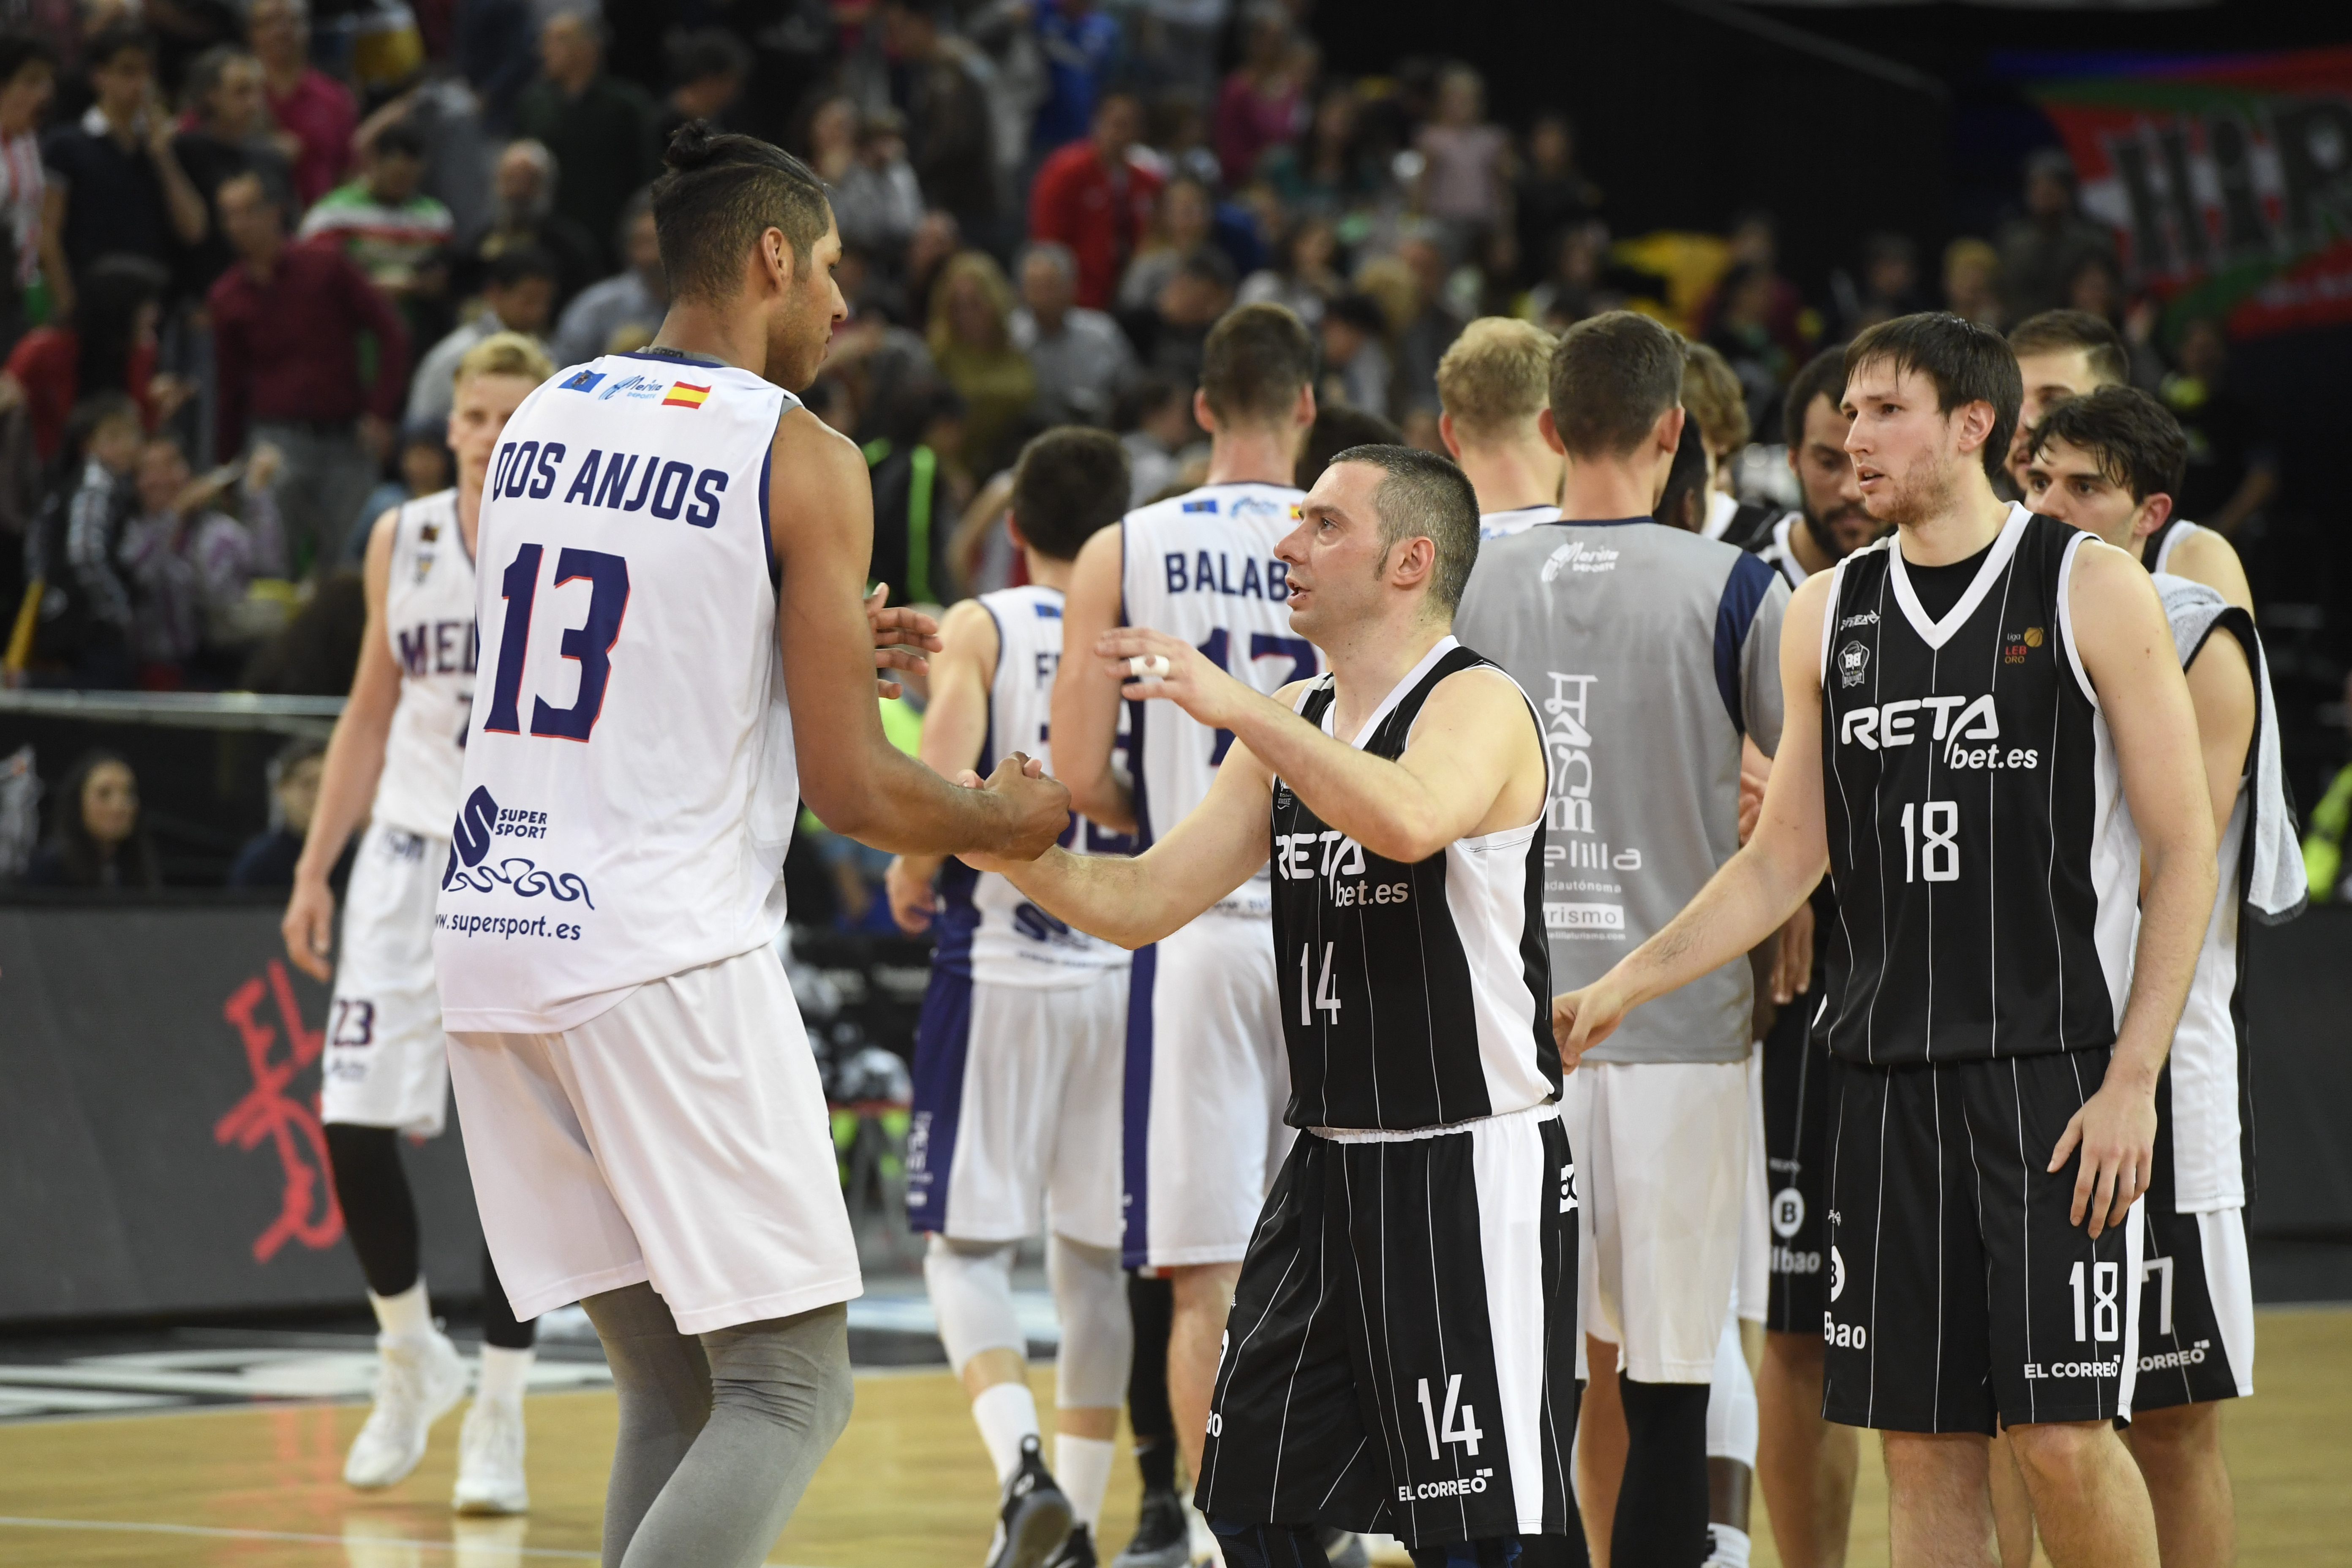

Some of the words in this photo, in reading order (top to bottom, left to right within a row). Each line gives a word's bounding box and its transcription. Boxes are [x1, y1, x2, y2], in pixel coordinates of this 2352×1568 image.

[492, 441, 566, 502] DOS
[564, 449, 729, 528] ANJOS
[1165, 550, 1290, 601] BALAB
[484, 543, 630, 743] 13
[2005, 645, 2027, 655] LEB
[2007, 632, 2021, 642] Liga
[2005, 656, 2025, 664] ORO
[1841, 694, 1999, 763] RETA
[1950, 743, 2038, 770] bet.es
[499, 808, 547, 824] SUPER
[495, 824, 547, 839] SPORT
[1900, 800, 1960, 883] 18
[1544, 840, 1642, 870] elilla
[1335, 880, 1408, 907] bet.es
[1544, 906, 1617, 924] rismo
[1300, 942, 1341, 1026] 14
[1781, 1202, 1796, 1223] B
[1771, 1246, 1821, 1274] lbao
[2069, 1261, 2118, 1342] 18
[2142, 1256, 2173, 1336] 7
[2024, 1363, 2049, 1378] EL
[2051, 1361, 2118, 1378] CORREO
[1418, 1374, 1483, 1460] 14
[1398, 1485, 1416, 1501] EL
[1417, 1477, 1487, 1499] CORREO
